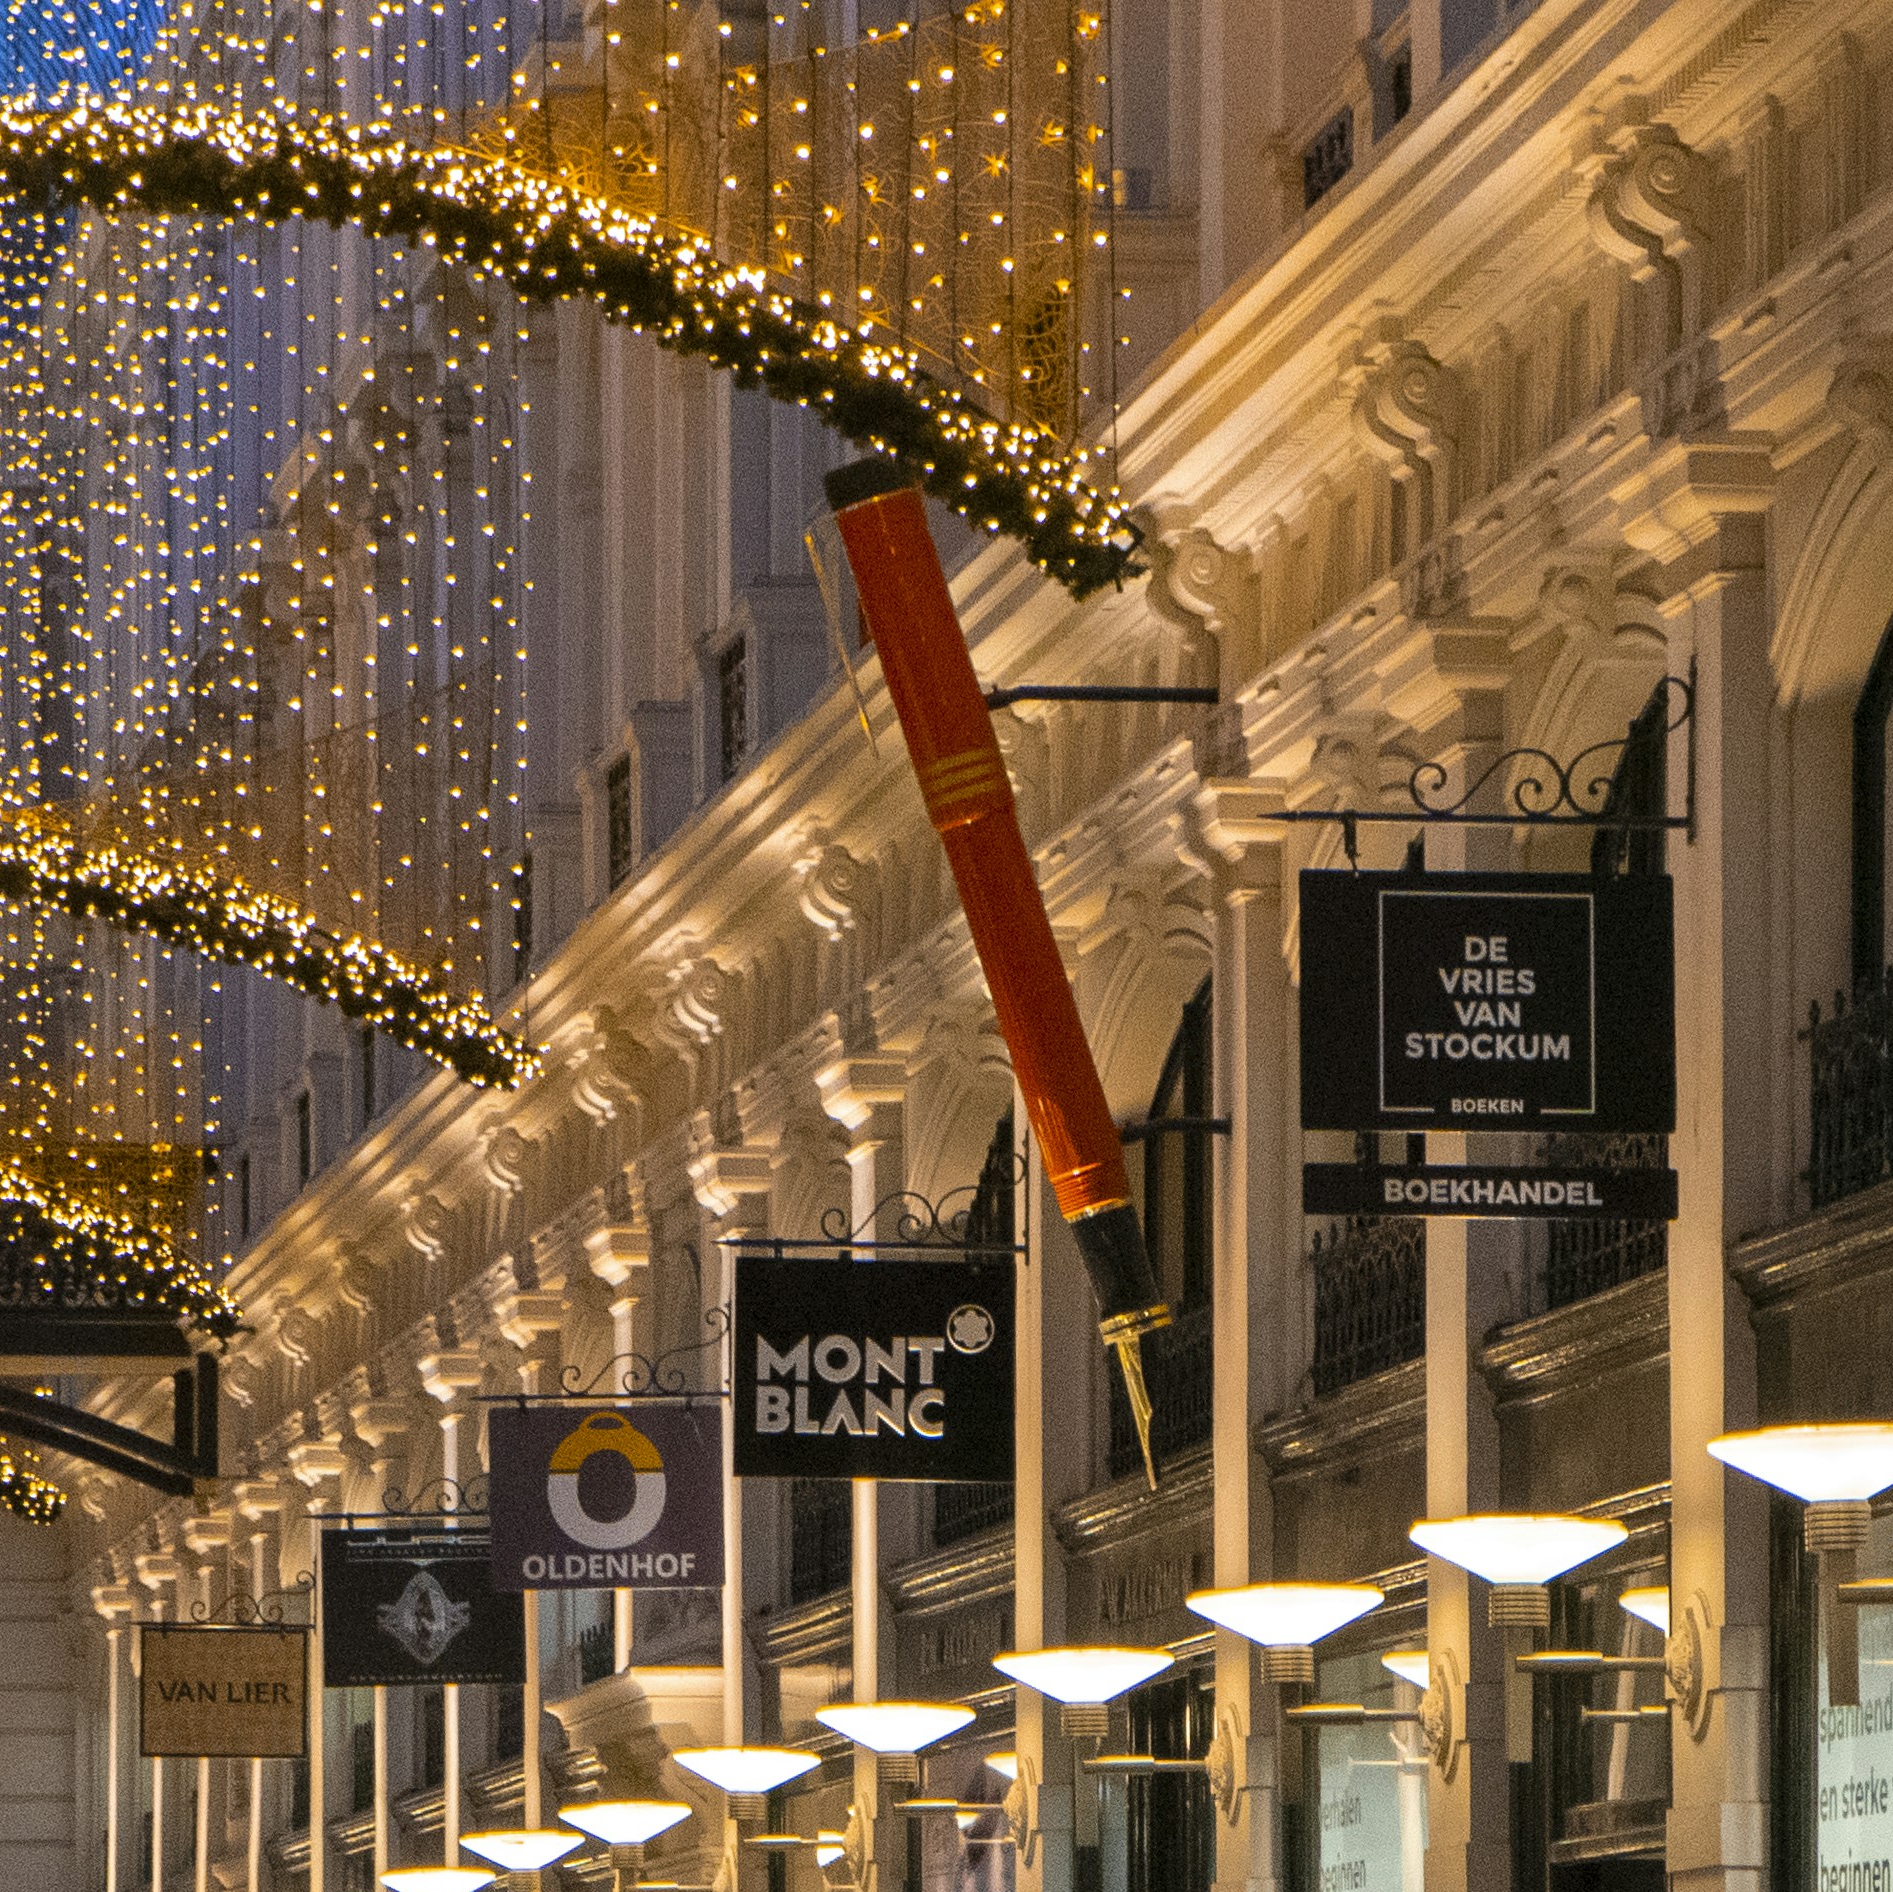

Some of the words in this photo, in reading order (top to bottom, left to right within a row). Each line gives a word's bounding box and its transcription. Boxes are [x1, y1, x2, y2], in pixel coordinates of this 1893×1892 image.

[1464, 936, 1508, 962] DE
[1438, 968, 1536, 996] VRIES
[1454, 1002, 1521, 1028] VAN
[1405, 1032, 1571, 1061] STOCKUM
[1451, 1097, 1525, 1115] BOEKEN
[1384, 1177, 1604, 1207] BOEKHANDEL
[755, 1334, 946, 1386] MONT
[755, 1386, 947, 1439] BLANC
[522, 1551, 698, 1582] OLDENHOF
[157, 1679, 219, 1706] VAN
[227, 1680, 292, 1706] LIER
[1820, 1783, 1838, 1823] en
[1842, 1766, 1888, 1820] sterke
